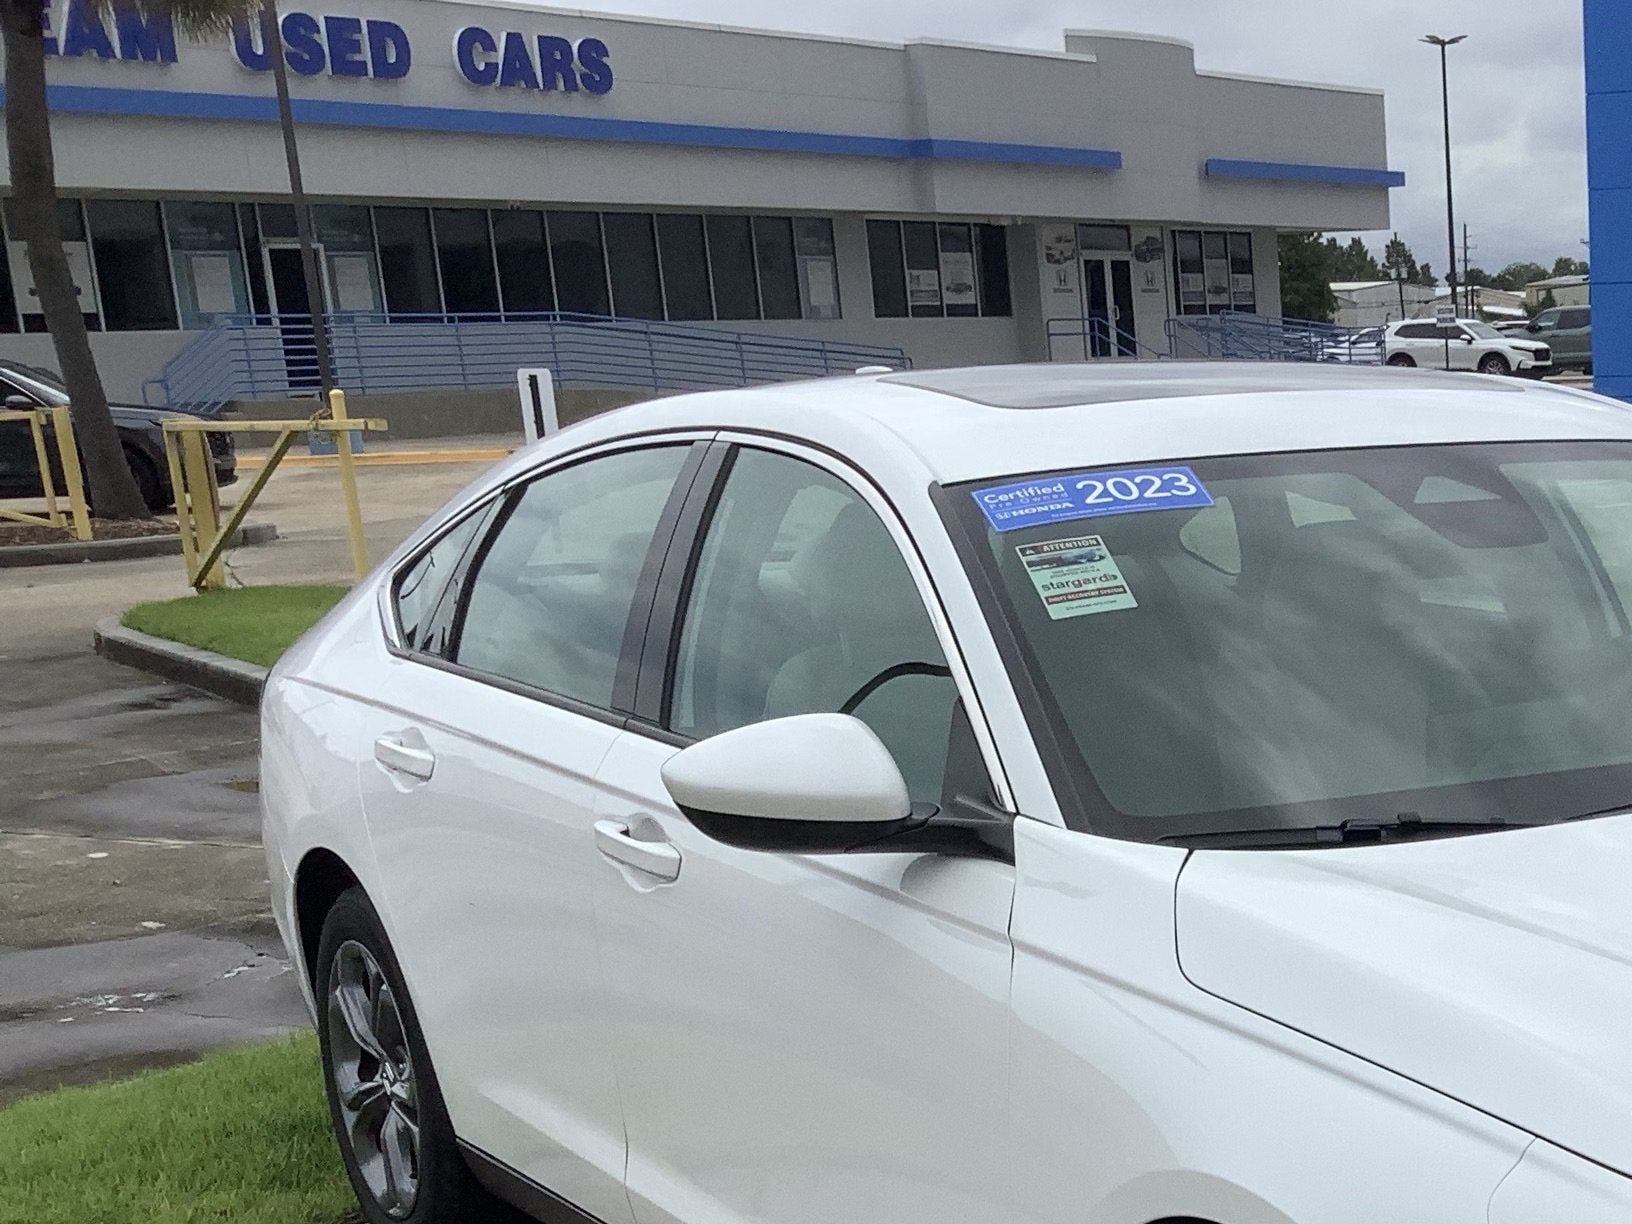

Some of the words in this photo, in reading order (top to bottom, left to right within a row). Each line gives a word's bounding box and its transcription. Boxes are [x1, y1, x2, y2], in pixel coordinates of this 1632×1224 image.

[232, 5, 411, 80] USED
[455, 26, 614, 95] CARS
[984, 483, 1065, 503] Certified
[1076, 473, 1197, 504] 2023
[1011, 502, 1075, 516] HONDA
[1043, 539, 1097, 552] ATTENTION
